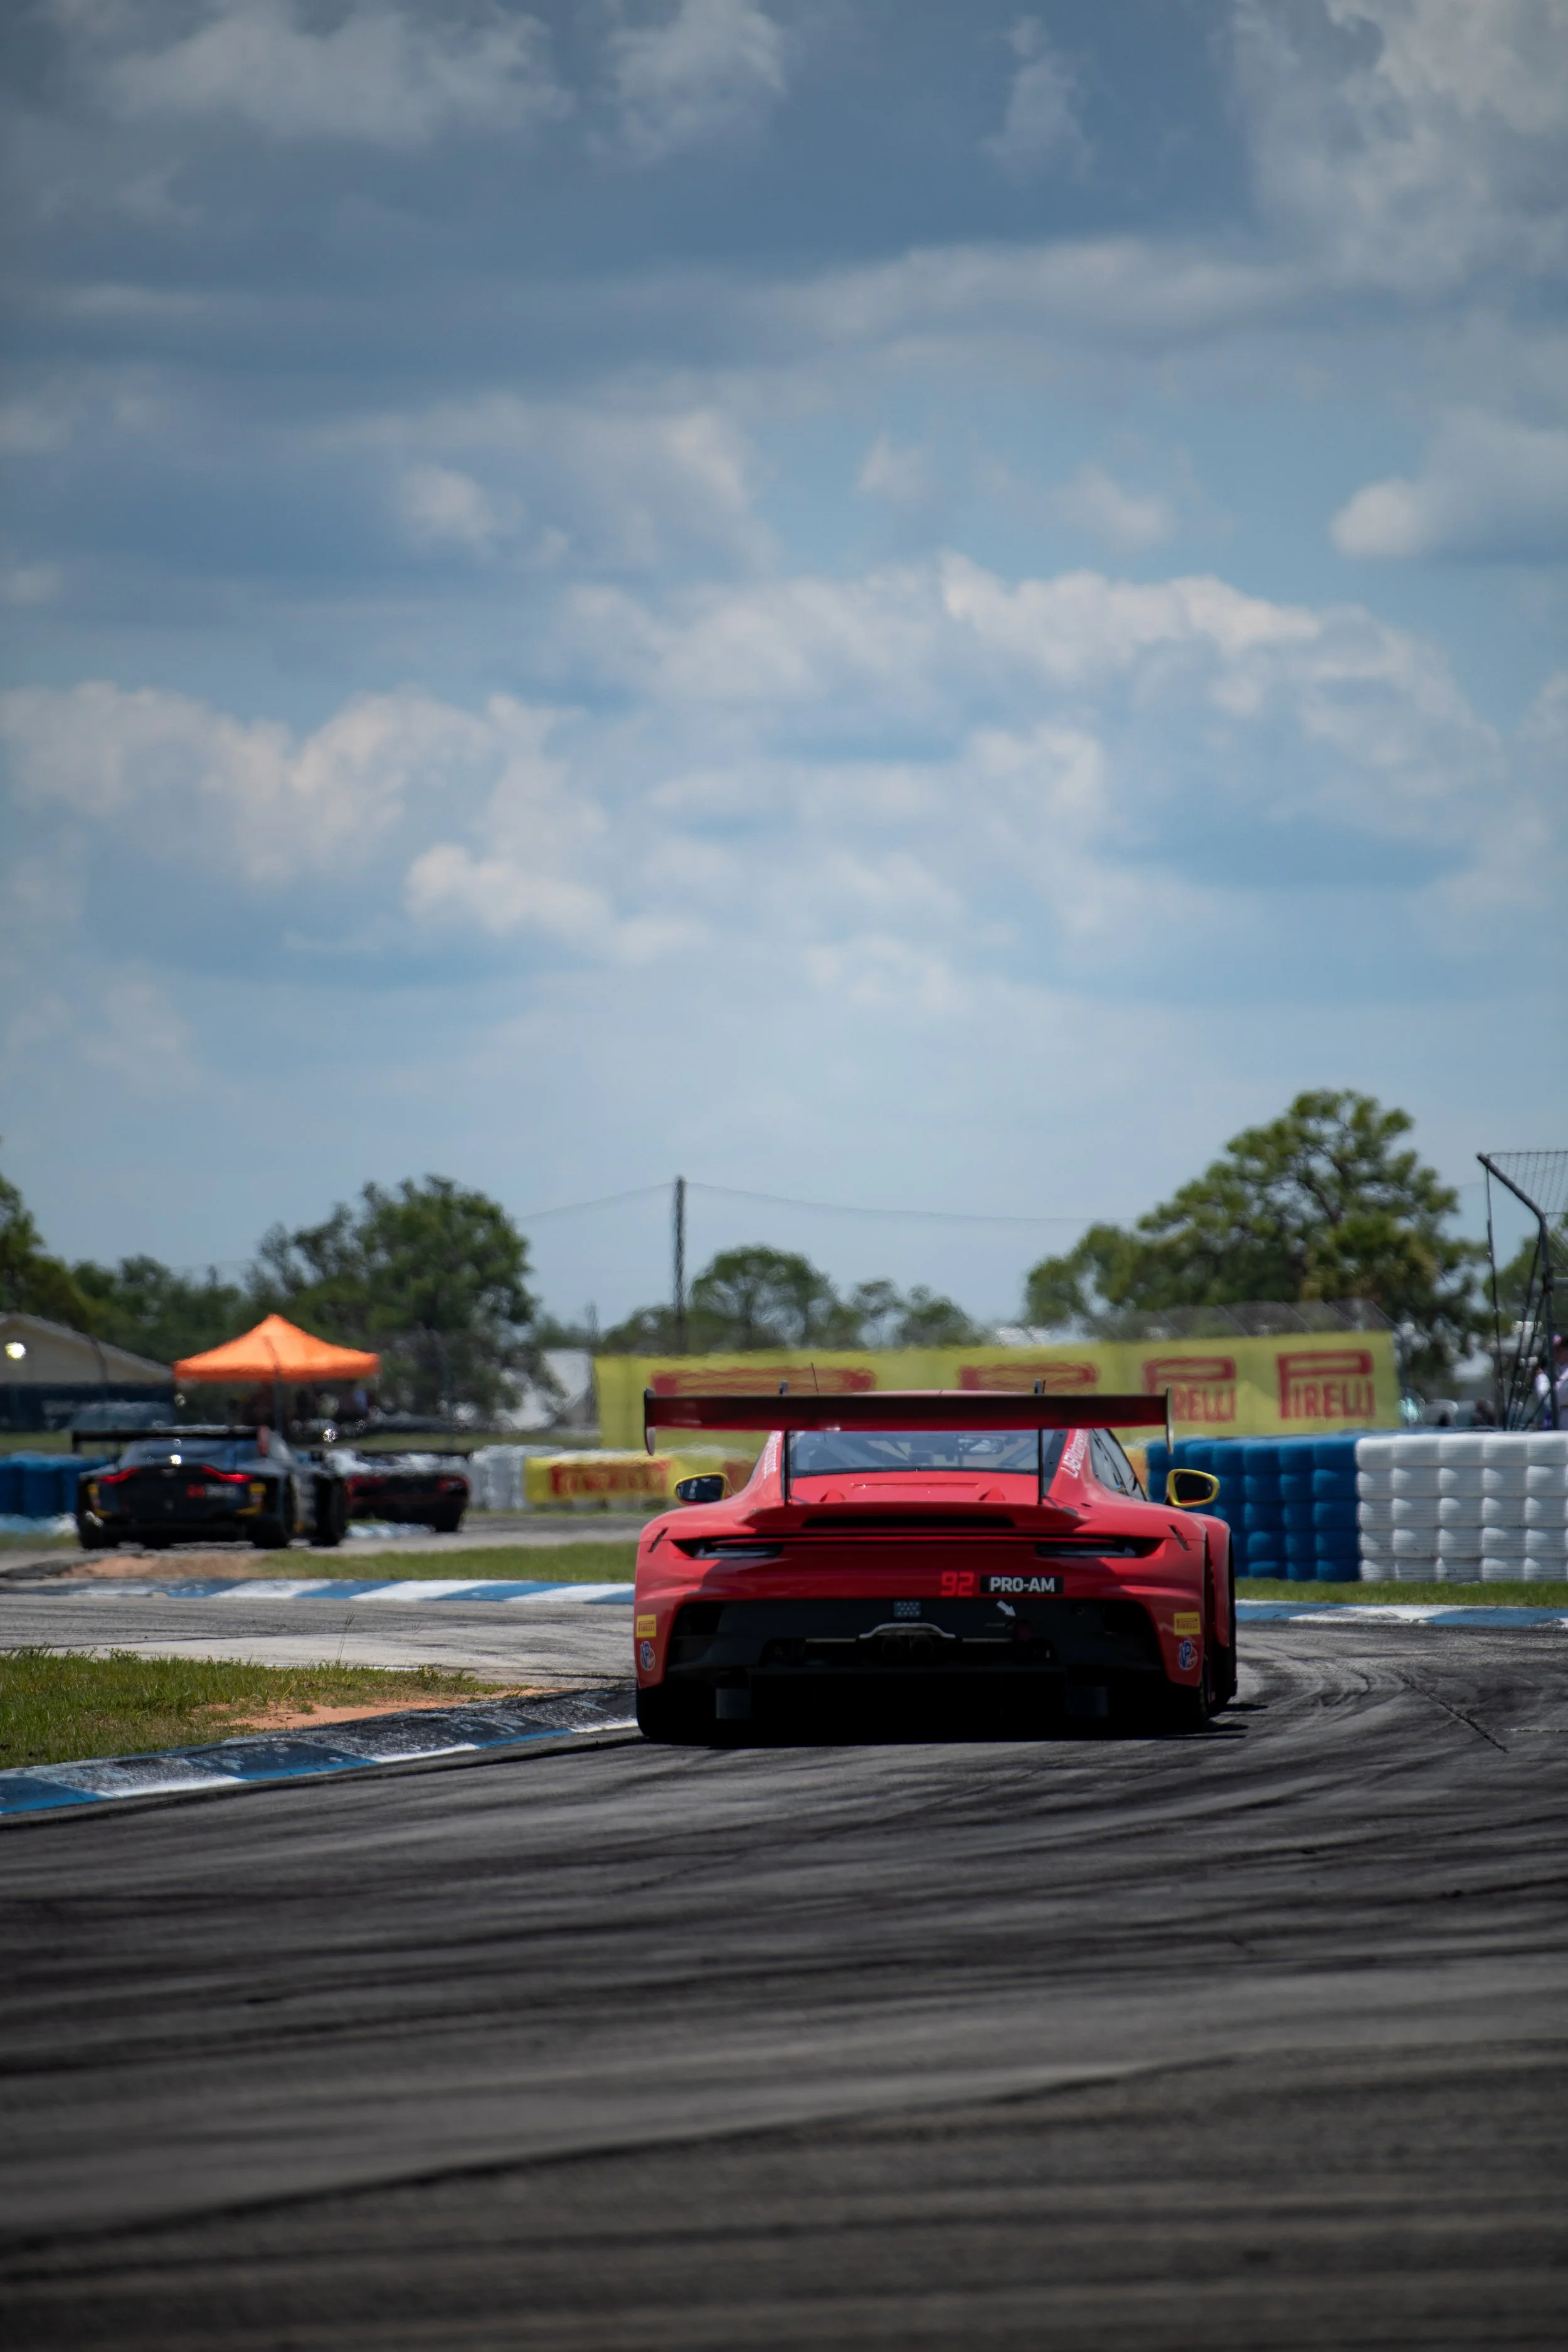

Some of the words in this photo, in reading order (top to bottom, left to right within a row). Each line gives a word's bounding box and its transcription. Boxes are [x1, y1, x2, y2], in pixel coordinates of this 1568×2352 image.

[1143, 1357, 1236, 1422] PRELLI
[1278, 1350, 1374, 1419] PIRELLI
[941, 1571, 974, 1596] 92
[990, 1577, 1055, 1592] PRO-AM
[638, 1621, 655, 1631] PIRELLI
[1177, 1618, 1199, 1629] PIRELLI
